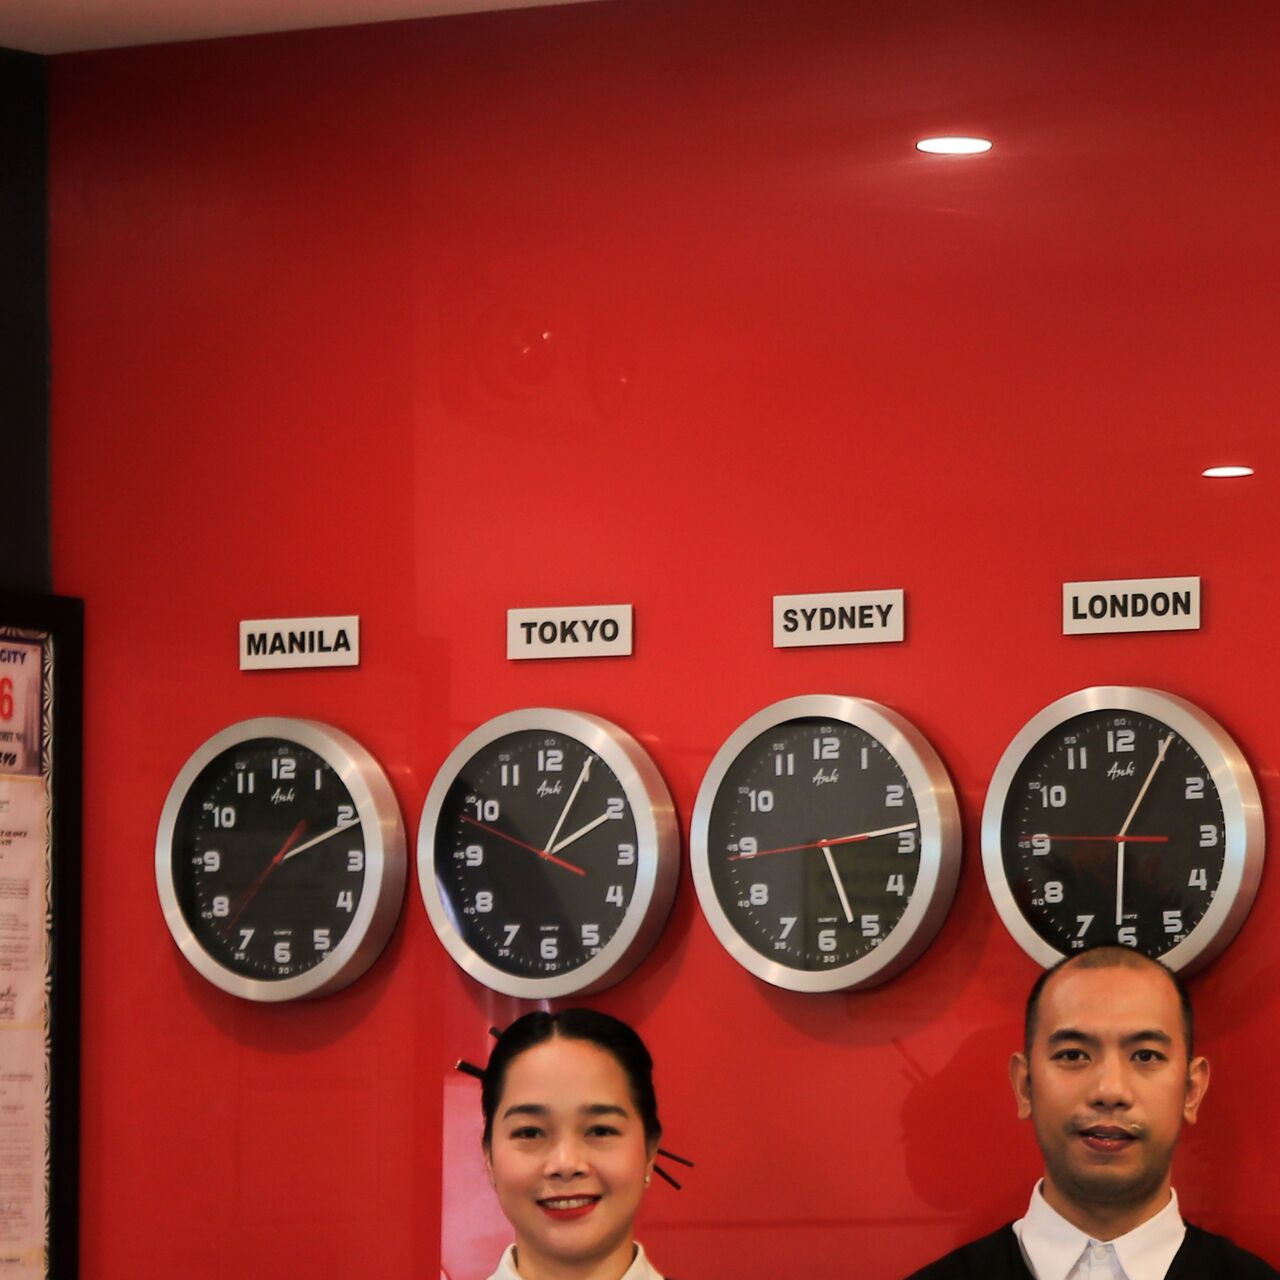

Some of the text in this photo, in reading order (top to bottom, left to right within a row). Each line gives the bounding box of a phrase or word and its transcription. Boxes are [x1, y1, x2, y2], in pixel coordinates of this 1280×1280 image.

[1071, 591, 1192, 620] LONDON
[782, 604, 894, 633] SYDNEY
[246, 628, 351, 656] MANILA
[520, 618, 620, 645] TOKYO
[813, 737, 840, 760] 12
[1107, 729, 1135, 753] 12
[271, 758, 296, 779] 12
[537, 750, 564, 772] 12
[775, 753, 794, 776] 11
[861, 747, 868, 770] 1
[1067, 747, 1087, 770] 11
[237, 772, 255, 794] 11
[315, 769, 321, 790] 1
[501, 764, 520, 786] 11
[885, 785, 904, 807] 2
[1040, 785, 1067, 808] 10
[1185, 777, 1204, 800] 2
[475, 800, 499, 821] 10
[606, 798, 624, 819] 2
[748, 790, 774, 813] 10
[212, 807, 236, 828] 10
[336, 805, 354, 828] 2
[897, 832, 916, 854] 3
[1031, 833, 1050, 856] 9
[1199, 824, 1218, 847] 3
[465, 845, 483, 867] 9
[617, 844, 635, 866] 3
[739, 836, 758, 859] 9
[203, 851, 220, 872] 9
[347, 851, 364, 872] 3
[886, 874, 905, 896] 4
[1187, 868, 1207, 891] 4
[336, 891, 354, 912] 4
[475, 891, 493, 913] 8
[605, 885, 624, 907] 4
[750, 883, 769, 905] 8
[1044, 881, 1064, 903] 8
[212, 896, 229, 917] 8
[779, 917, 798, 939] 7
[861, 914, 880, 937] 5
[1076, 915, 1095, 938] 7
[1162, 910, 1183, 933] 5
[239, 929, 256, 950] 7
[313, 929, 331, 950] 5
[503, 924, 521, 946] 7
[581, 924, 600, 946] 5
[818, 929, 837, 952] 6
[1117, 926, 1137, 947] 6
[273, 942, 291, 963] 6
[540, 938, 558, 959] 6
